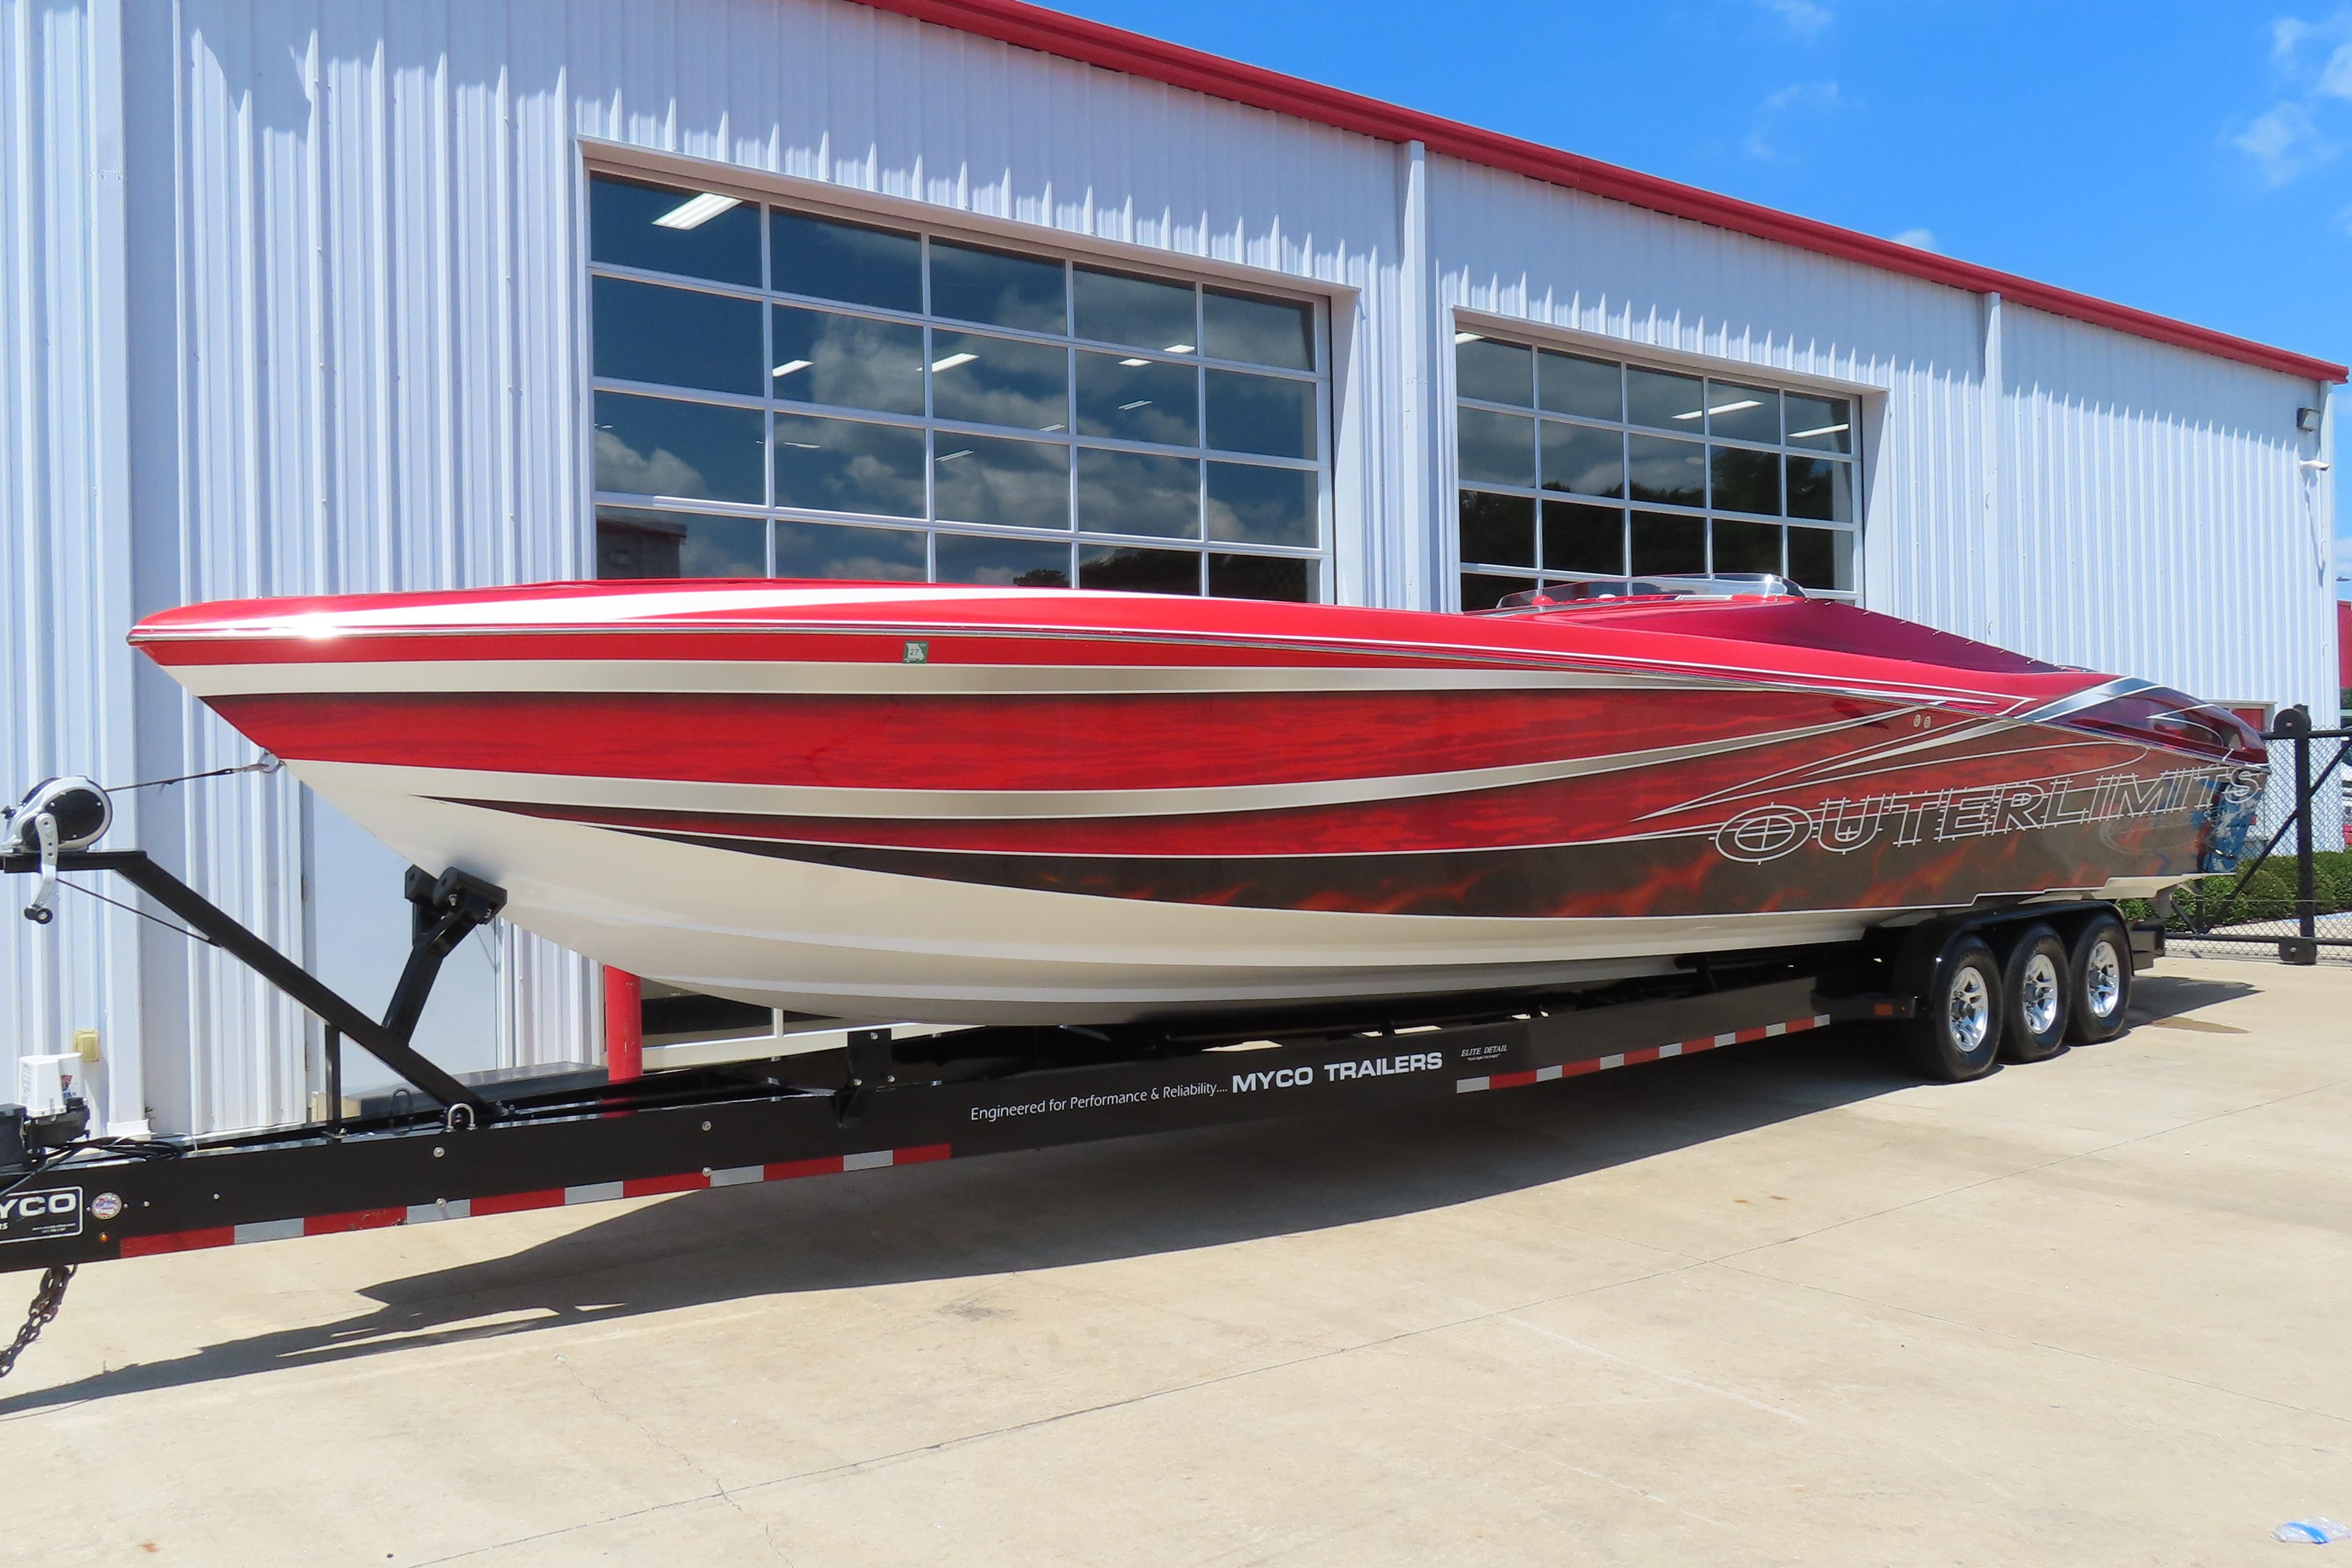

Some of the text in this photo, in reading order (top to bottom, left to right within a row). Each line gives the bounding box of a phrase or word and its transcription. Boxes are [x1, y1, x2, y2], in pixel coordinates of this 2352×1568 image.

[1711, 767, 2265, 864] OUTERLIMITS
[1460, 1047, 1482, 1057] ELITE
[1483, 1044, 1508, 1054] DETAIL
[971, 1100, 1045, 1122] Engineered
[1049, 1098, 1067, 1111] for
[1070, 1091, 1147, 1109] Performance
[1151, 1087, 1159, 1100] &
[1233, 1067, 1313, 1093] MYCO
[1324, 1052, 1443, 1082] TRAILERS
[0, 1193, 76, 1219] YCO
